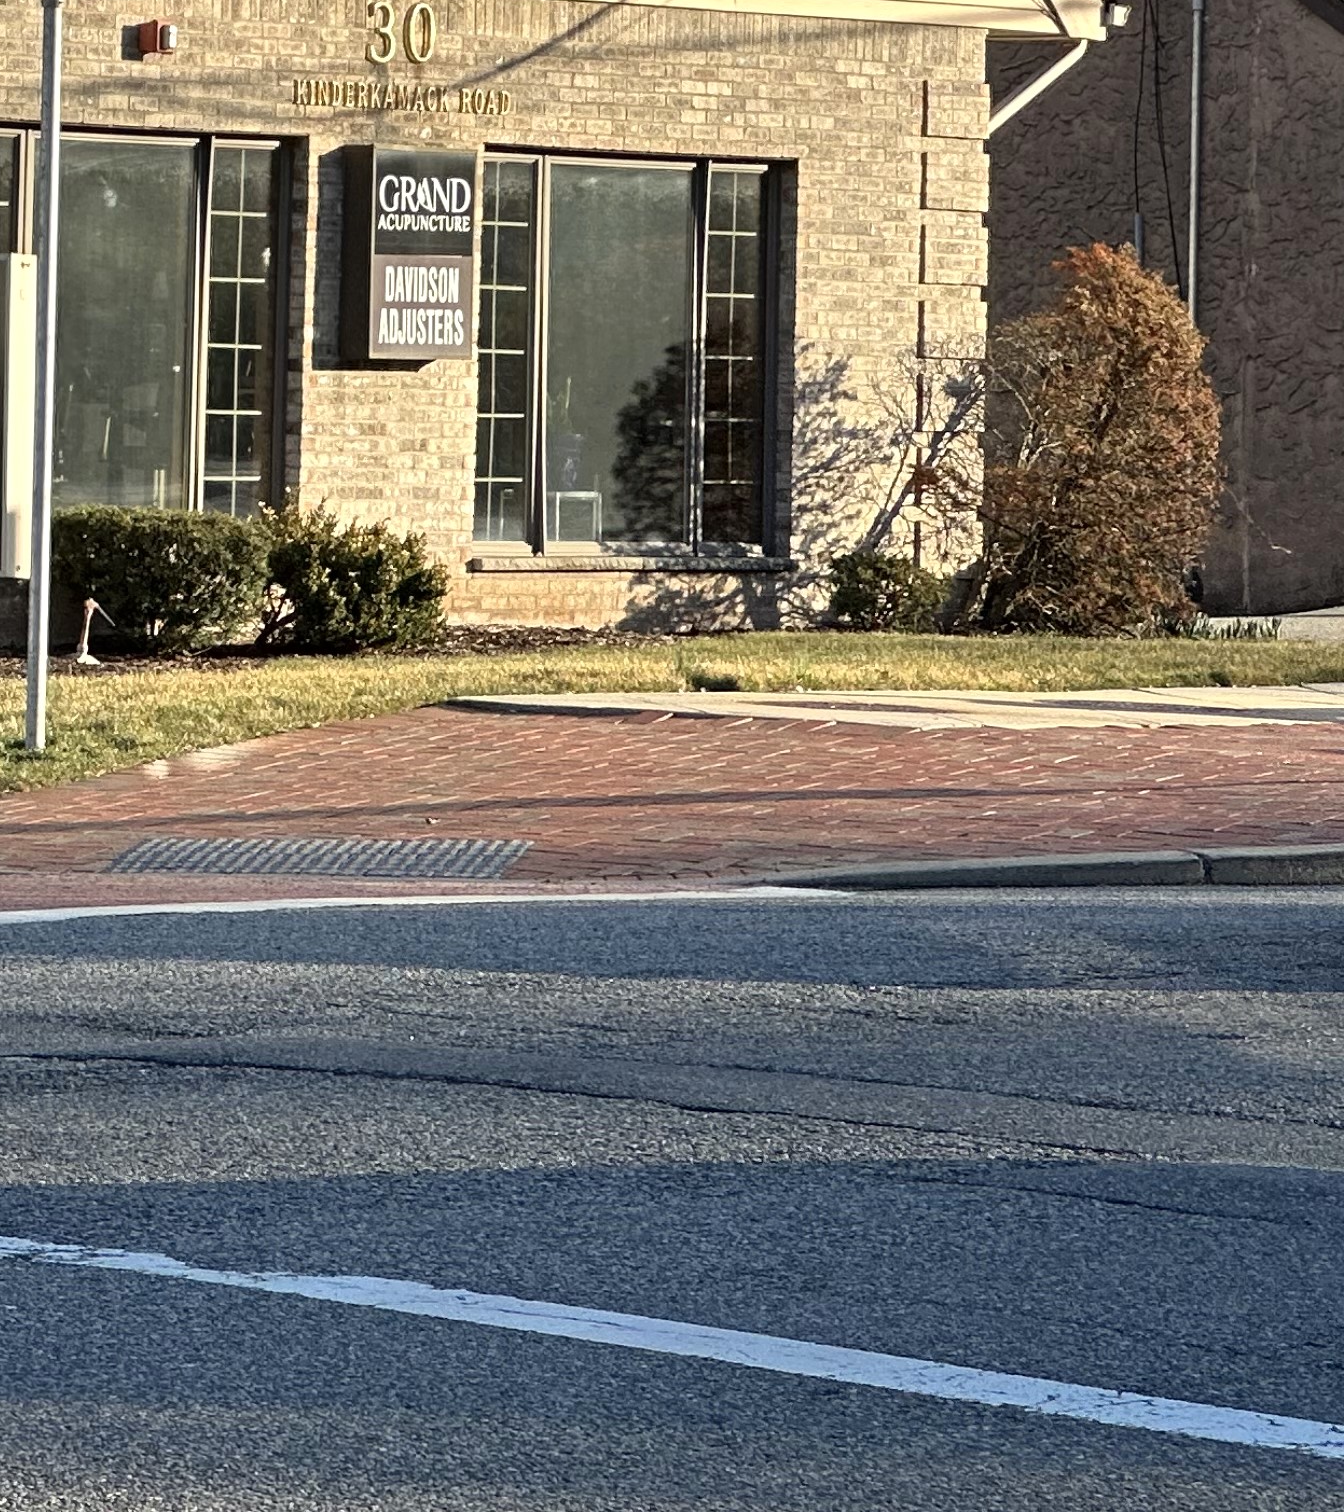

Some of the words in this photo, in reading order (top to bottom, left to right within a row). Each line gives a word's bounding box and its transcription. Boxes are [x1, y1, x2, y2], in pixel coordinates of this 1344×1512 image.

[365, 0, 437, 65] 30
[293, 79, 451, 113] KINDERKAMACK
[459, 88, 512, 115] ROAD
[378, 174, 472, 213] GRAND
[377, 214, 471, 233] ACUPUNCTURE
[385, 266, 460, 304] DAVIDSON
[378, 307, 465, 346] ADJUSTERS
